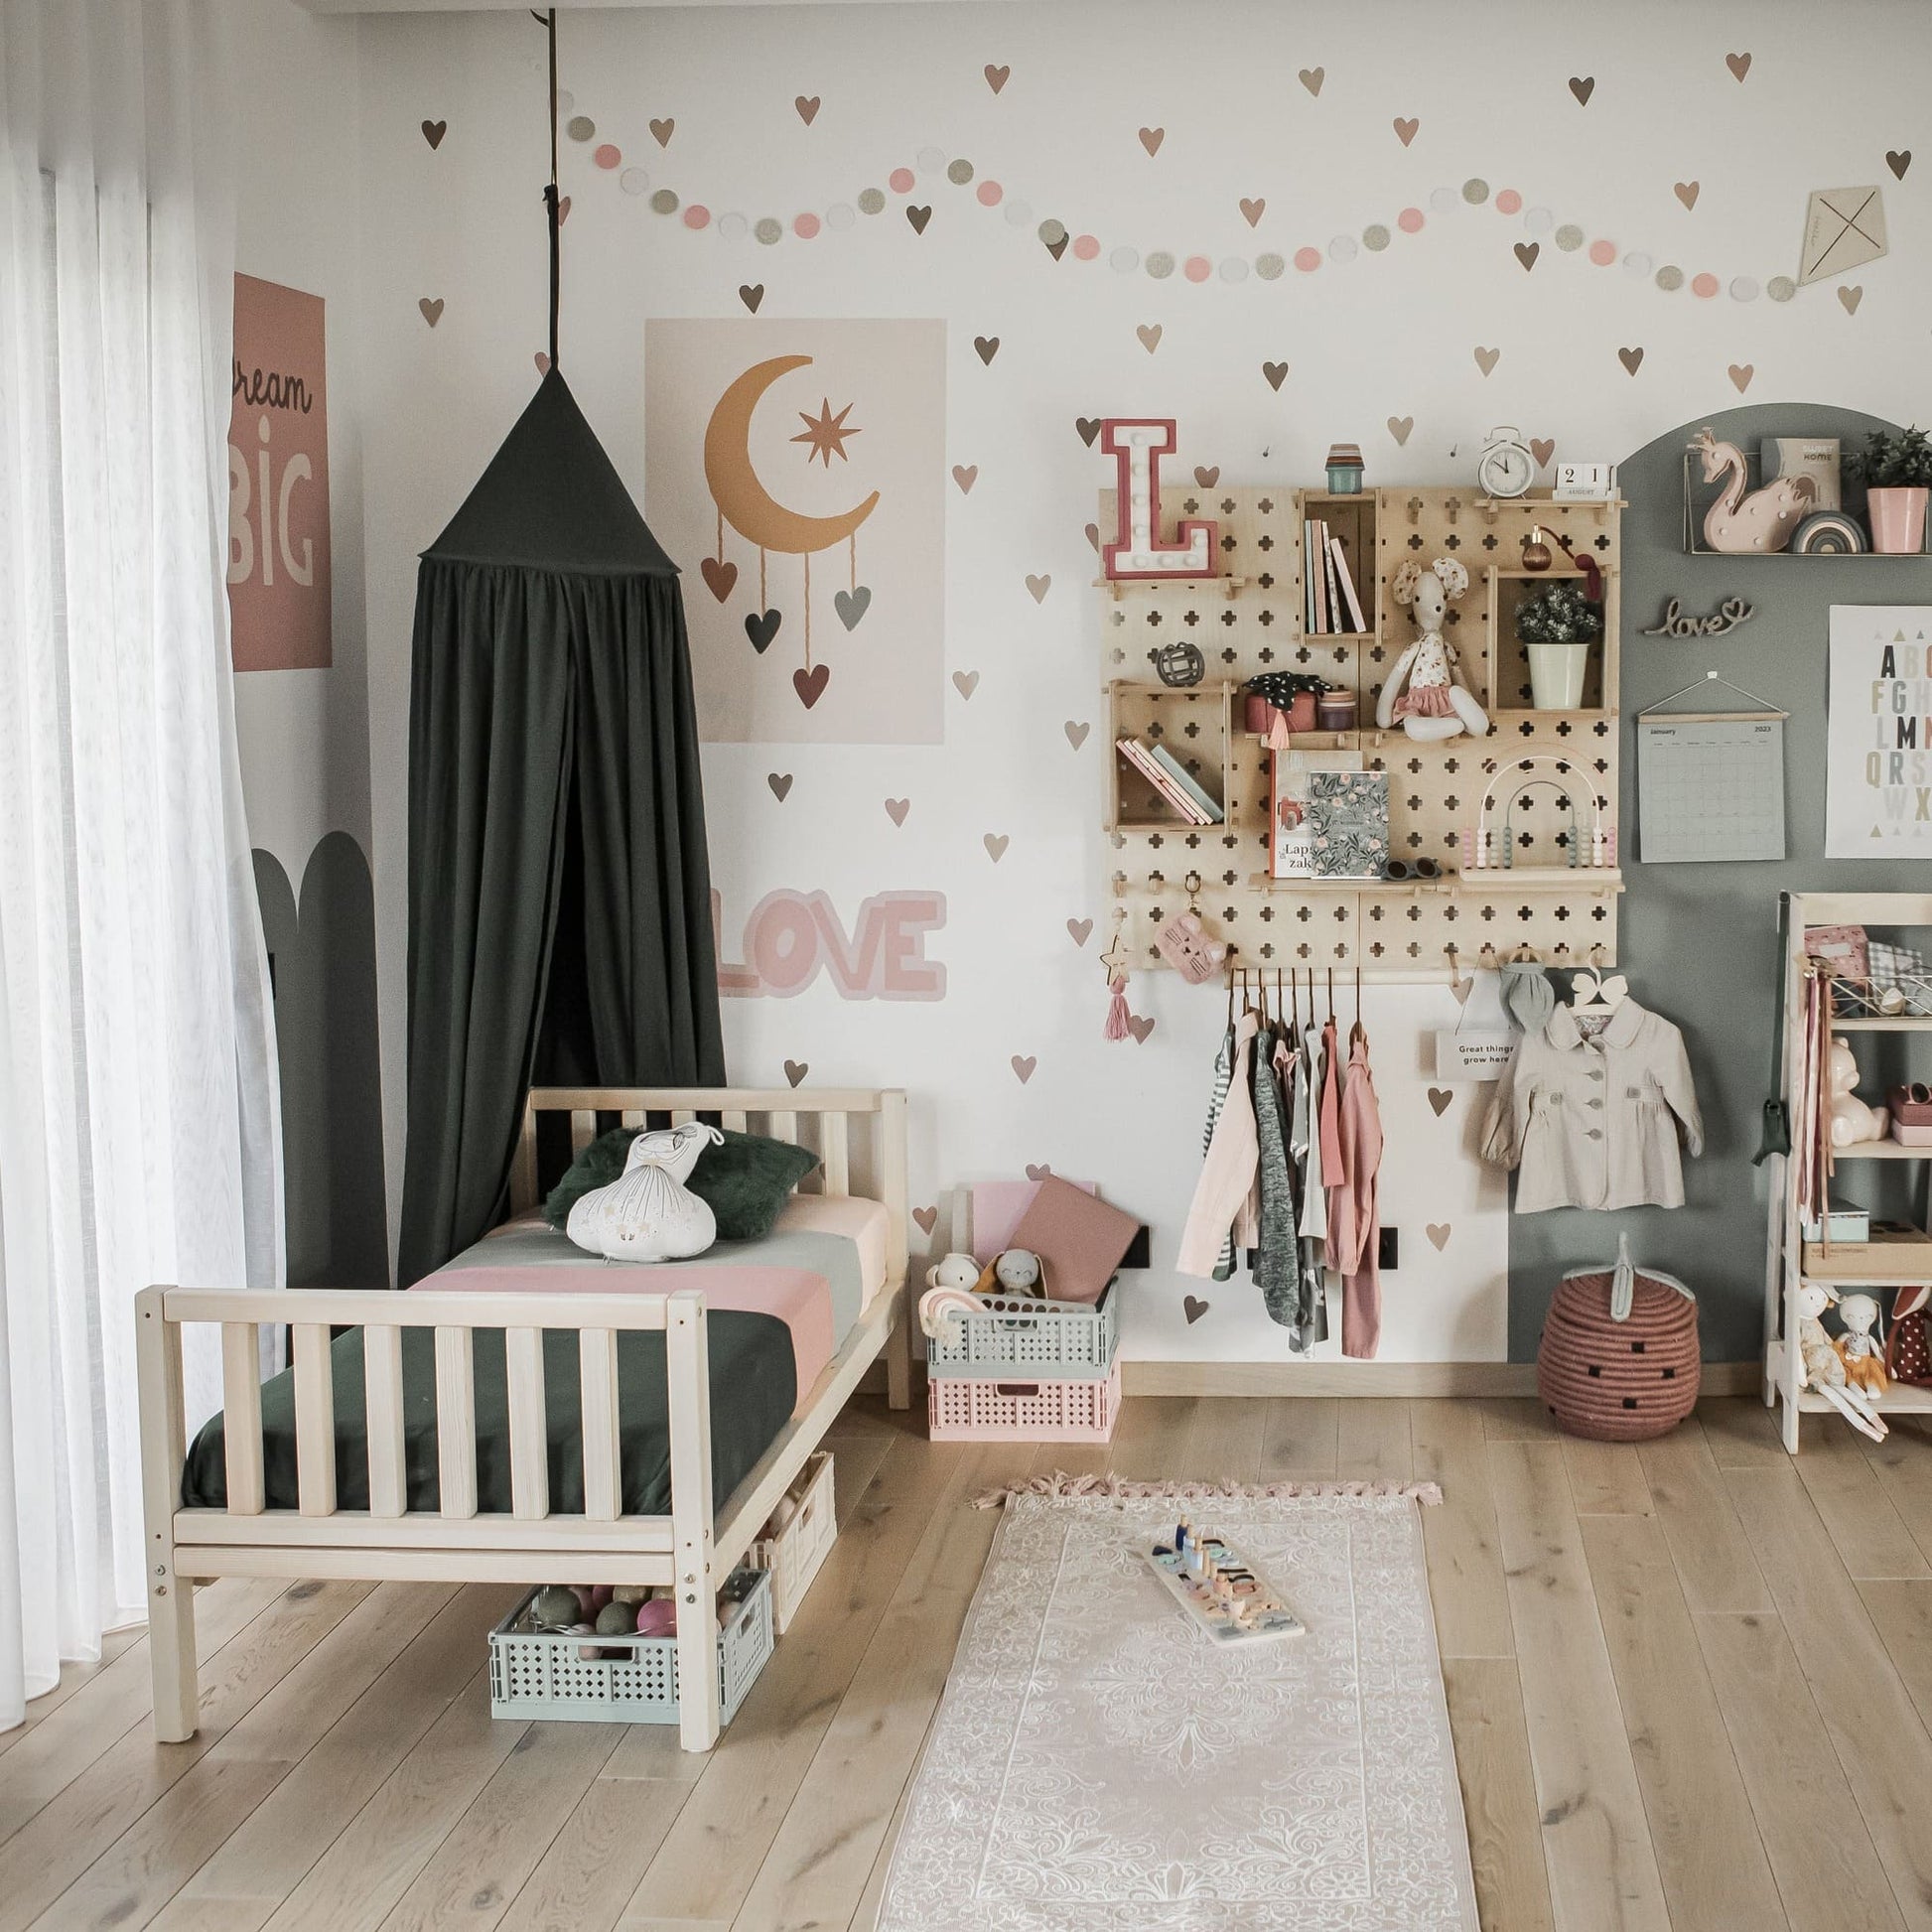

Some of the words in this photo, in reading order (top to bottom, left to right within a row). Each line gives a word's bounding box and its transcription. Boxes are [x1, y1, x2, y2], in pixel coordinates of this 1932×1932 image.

[1101, 419, 1217, 580] L
[1643, 597, 1735, 637] love
[1286, 844, 1311, 857] Lap
[1463, 1056, 1487, 1065] grow
